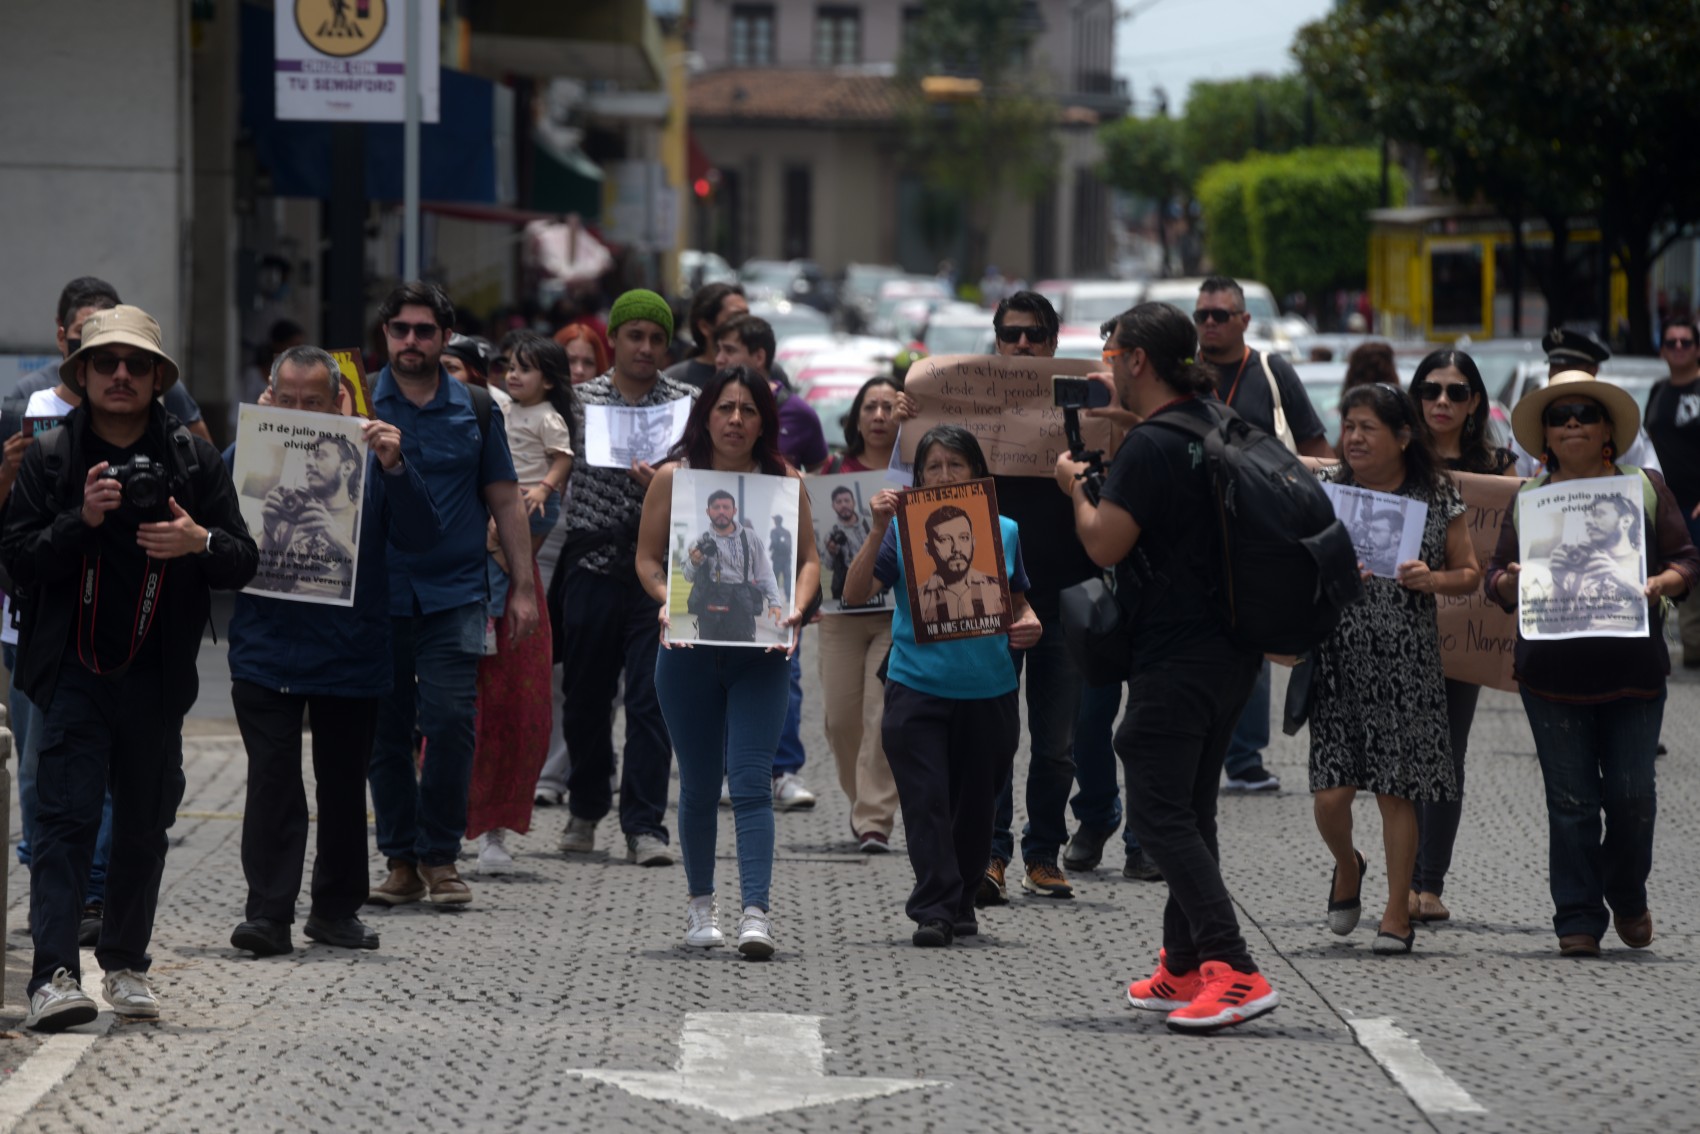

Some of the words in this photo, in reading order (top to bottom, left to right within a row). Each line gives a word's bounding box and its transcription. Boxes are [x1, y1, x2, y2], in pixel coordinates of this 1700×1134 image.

[288, 77, 309, 91] TU
[974, 360, 1039, 380] activismo
[941, 380, 975, 396] desde
[1004, 383, 1051, 405] periodis
[258, 422, 274, 432] ¡31
[276, 424, 290, 434] de
[292, 425, 316, 437] julio
[318, 430, 332, 439] no
[334, 433, 347, 441] se
[284, 440, 320, 452] olvida!
[1553, 494, 1566, 503] de
[1567, 491, 1592, 502] julio
[1594, 492, 1607, 500] no
[83, 568, 94, 605] Canon
[145, 572, 158, 599] EOS
[142, 599, 152, 614] 6D
[926, 623, 939, 636] NO
[940, 620, 958, 634] NOS
[1466, 618, 1514, 655] Narva
